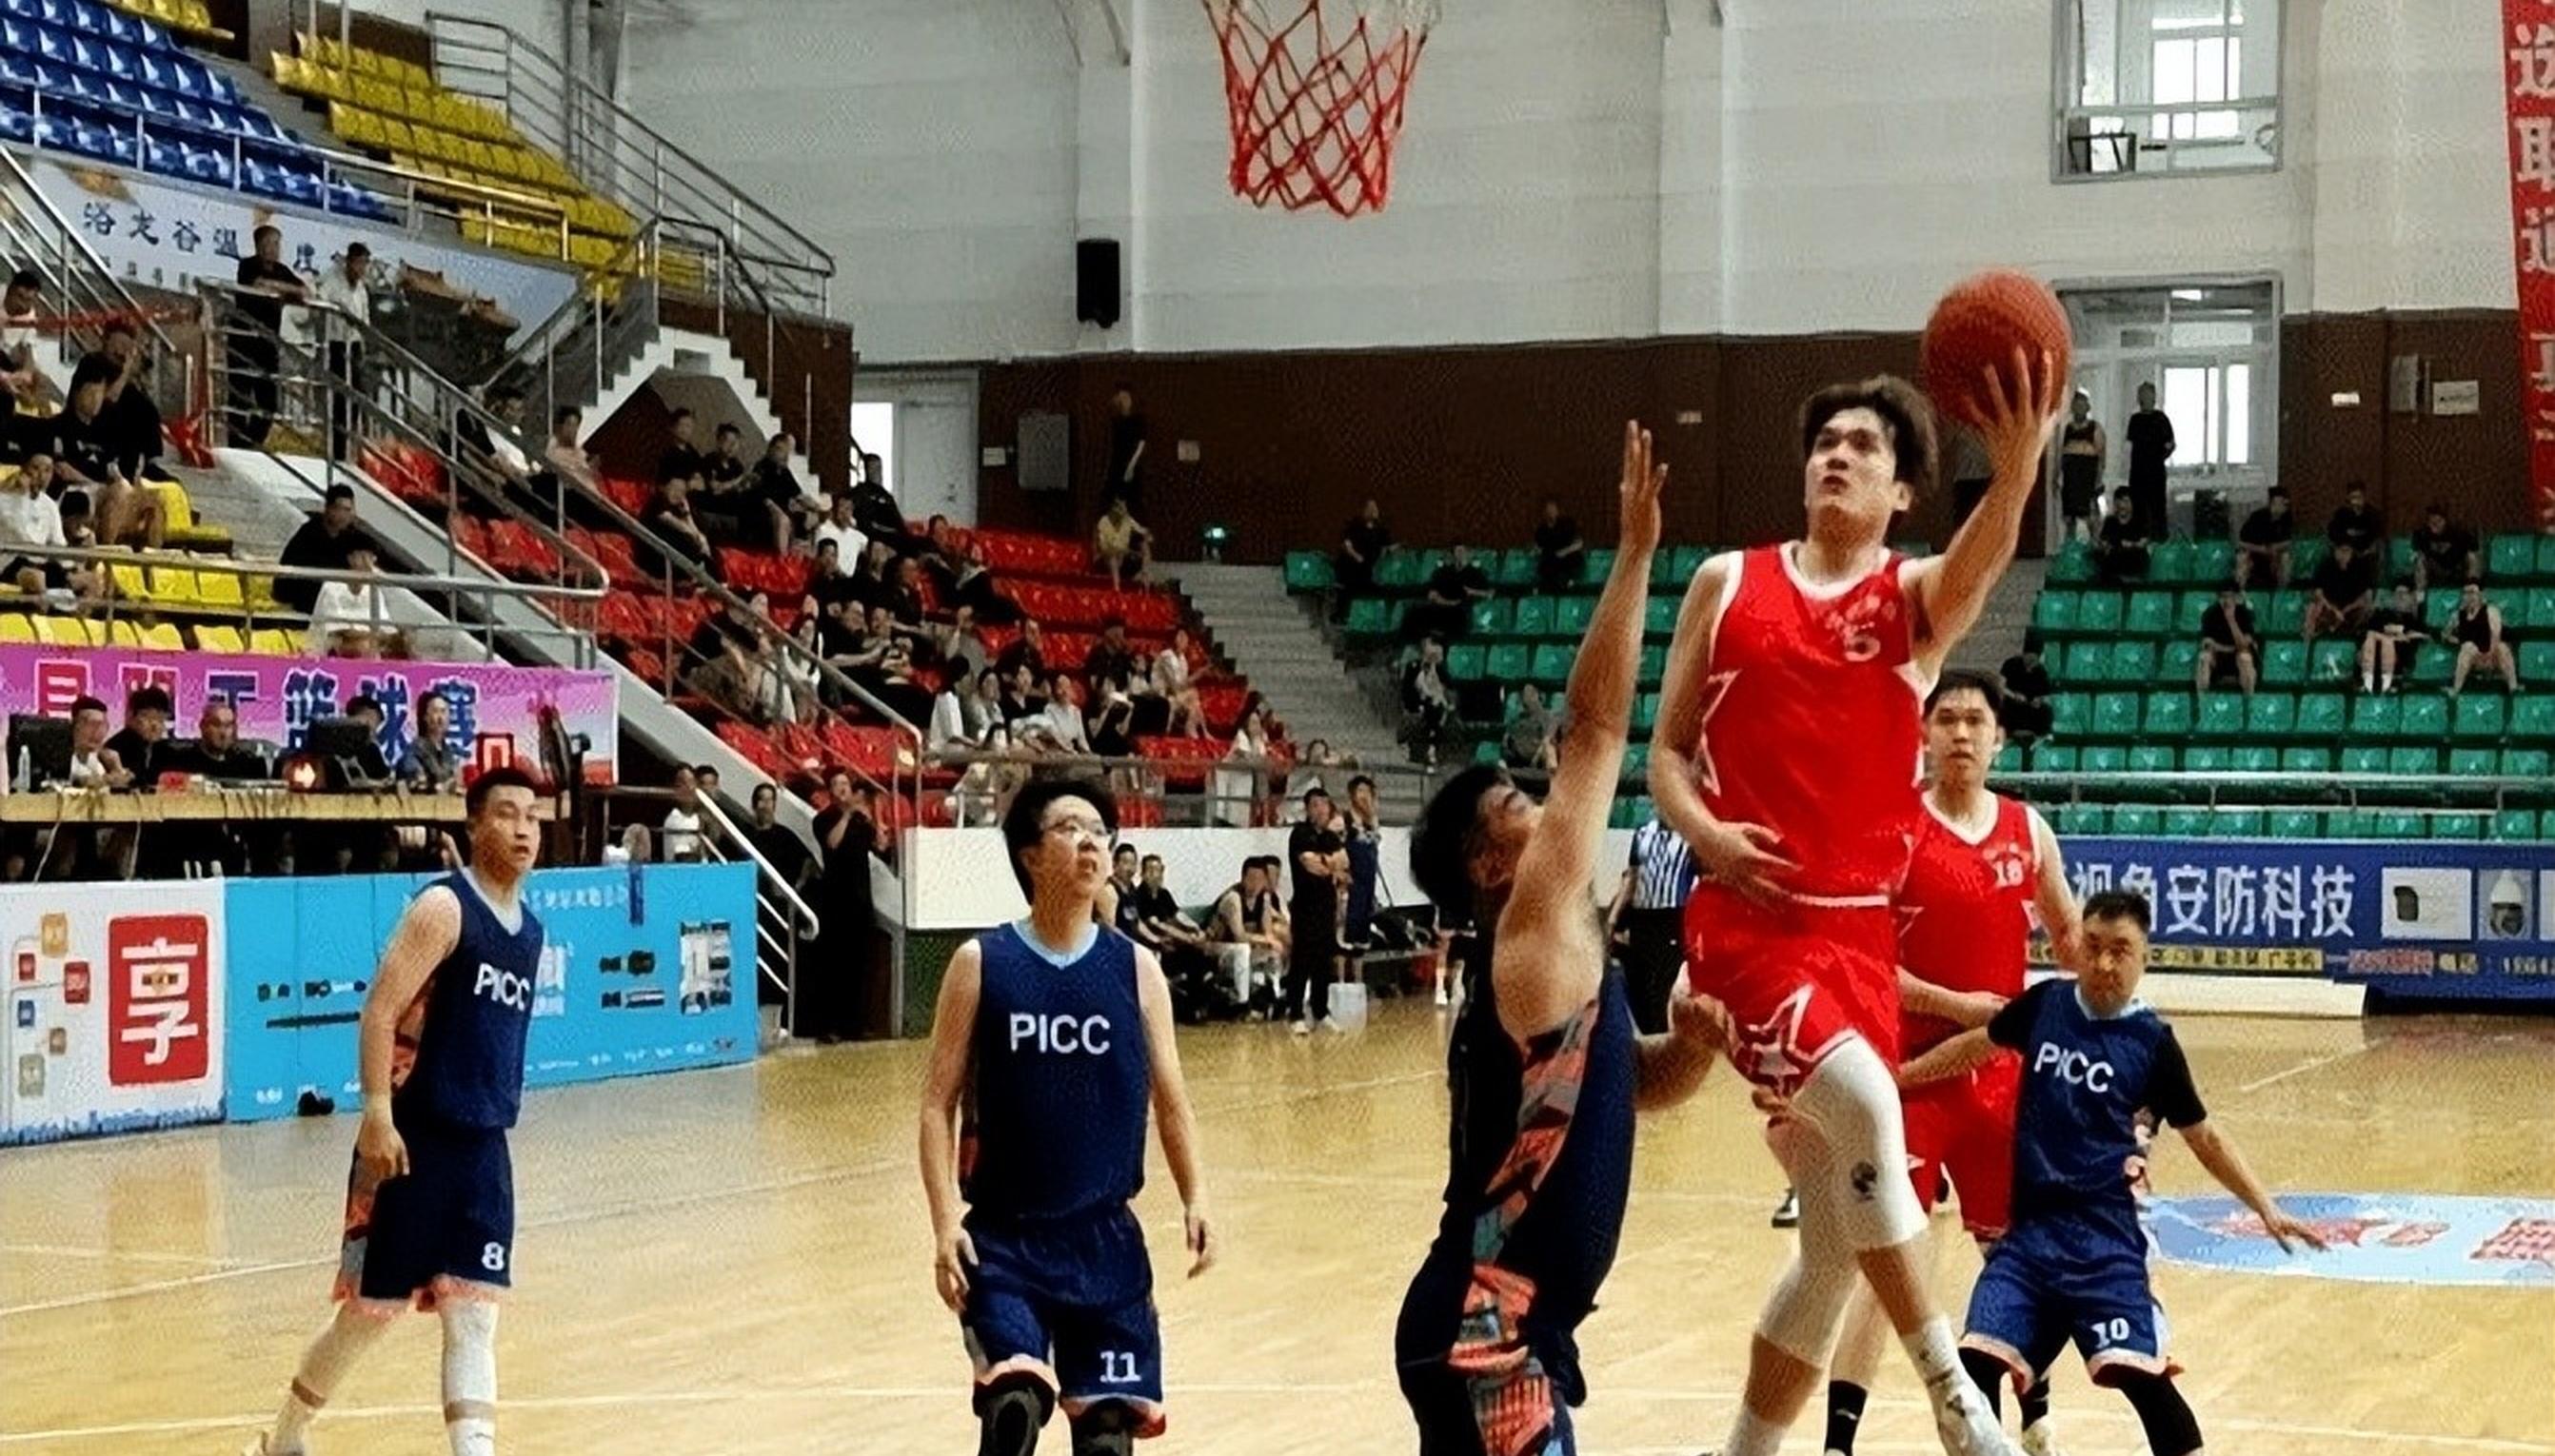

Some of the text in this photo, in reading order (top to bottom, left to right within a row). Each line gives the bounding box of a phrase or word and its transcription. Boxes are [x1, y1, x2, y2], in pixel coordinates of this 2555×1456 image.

[120, 936, 199, 1066] 享
[473, 962, 531, 1012] PICC
[1009, 1012, 1111, 1055] PICC
[2033, 1040, 2114, 1093] PICC
[481, 1241, 505, 1271] 8
[2090, 1317, 2130, 1349] 10
[1099, 1349, 1141, 1383] 11
